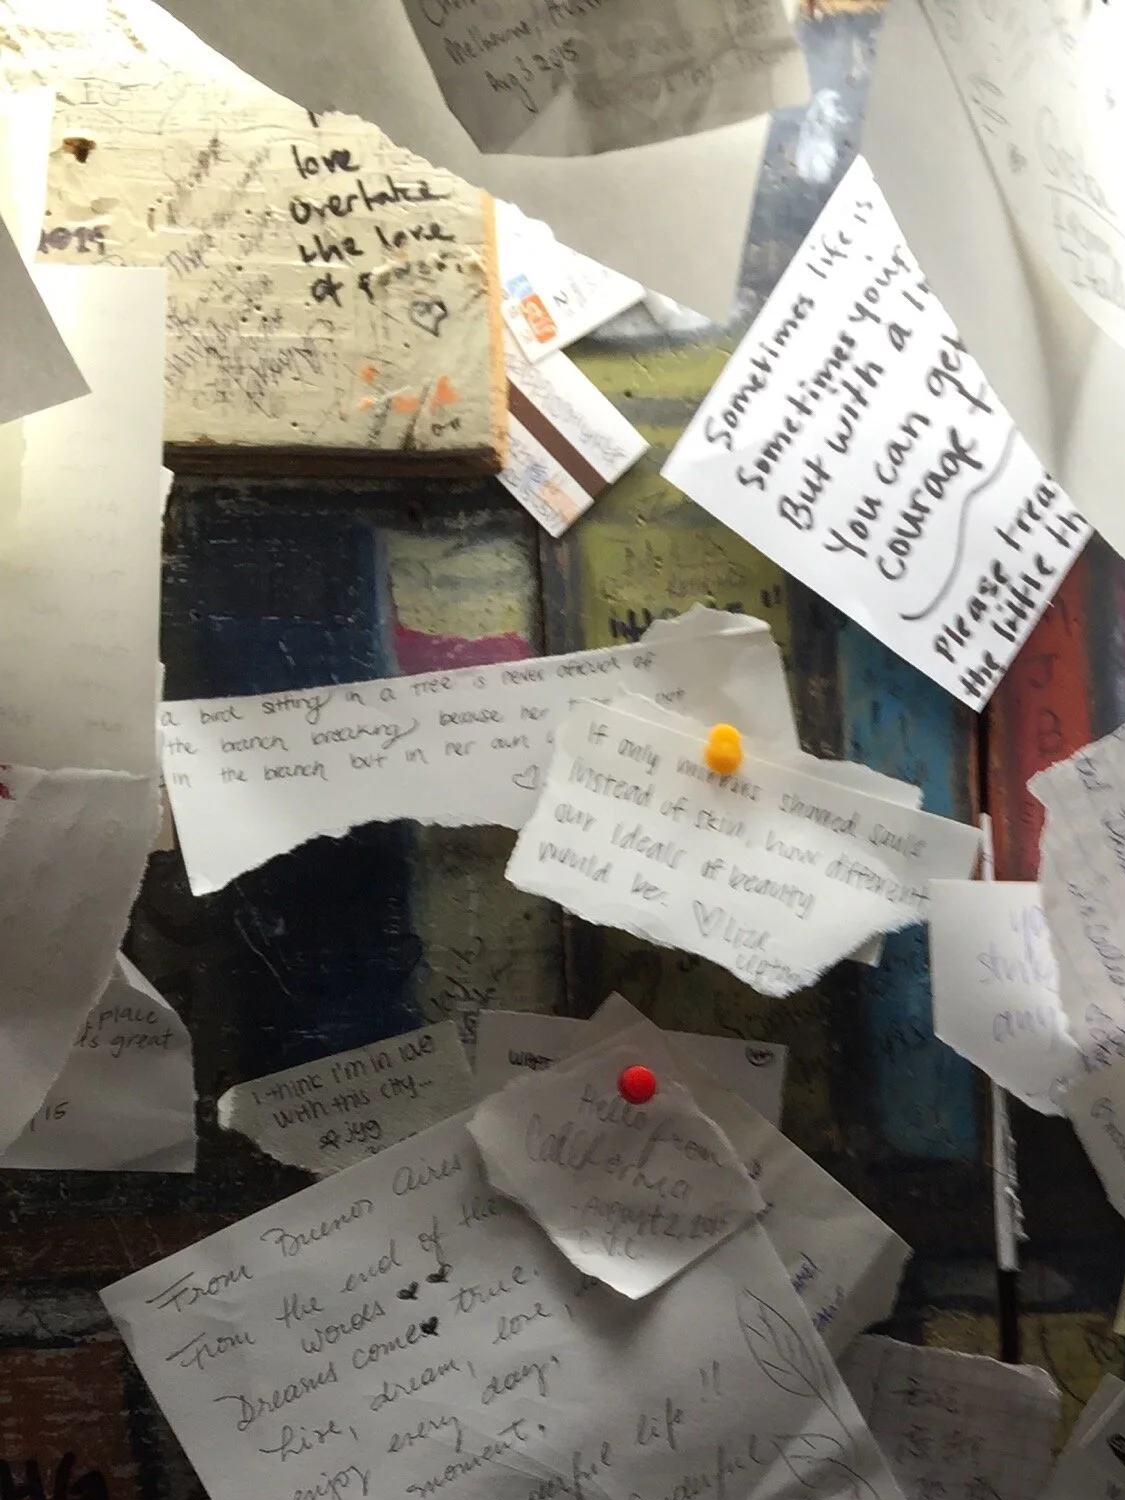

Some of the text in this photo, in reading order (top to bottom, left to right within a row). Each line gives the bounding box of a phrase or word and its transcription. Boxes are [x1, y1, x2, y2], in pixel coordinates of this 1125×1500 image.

[291, 144, 361, 181] love
[297, 221, 458, 265] the love
[309, 271, 346, 308] of
[704, 198, 875, 453] Sometimes life is
[736, 328, 861, 491] Sometimes
[776, 321, 916, 532] But with a
[876, 409, 933, 490] can
[876, 426, 984, 583] courage
[958, 551, 1059, 698] the little
[161, 652, 656, 728] a bird sitting in a is never afraid of
[166, 704, 551, 757] the branch breaking because her
[172, 770, 193, 789] in
[218, 761, 250, 784] the
[262, 760, 330, 783] branch
[348, 750, 389, 772] but
[404, 746, 430, 765] in
[444, 737, 478, 758] her
[617, 737, 662, 776] only
[553, 801, 600, 833] our
[700, 856, 729, 882] of
[727, 864, 818, 922] beauty
[659, 794, 690, 821] of
[823, 850, 932, 911] different
[99, 1003, 161, 1032] place
[109, 1028, 176, 1060] great
[368, 1048, 395, 1072] in
[271, 1096, 333, 1131] with
[333, 1089, 373, 1115] this
[578, 1082, 652, 1132] Hello
[156, 1154, 463, 1314] From Buenos Aires
[165, 1214, 451, 1371] From the end of
[214, 1362, 340, 1432] Dreams
[351, 1322, 425, 1371] come
[386, 1413, 466, 1455] every
[405, 1417, 548, 1499] moment.
